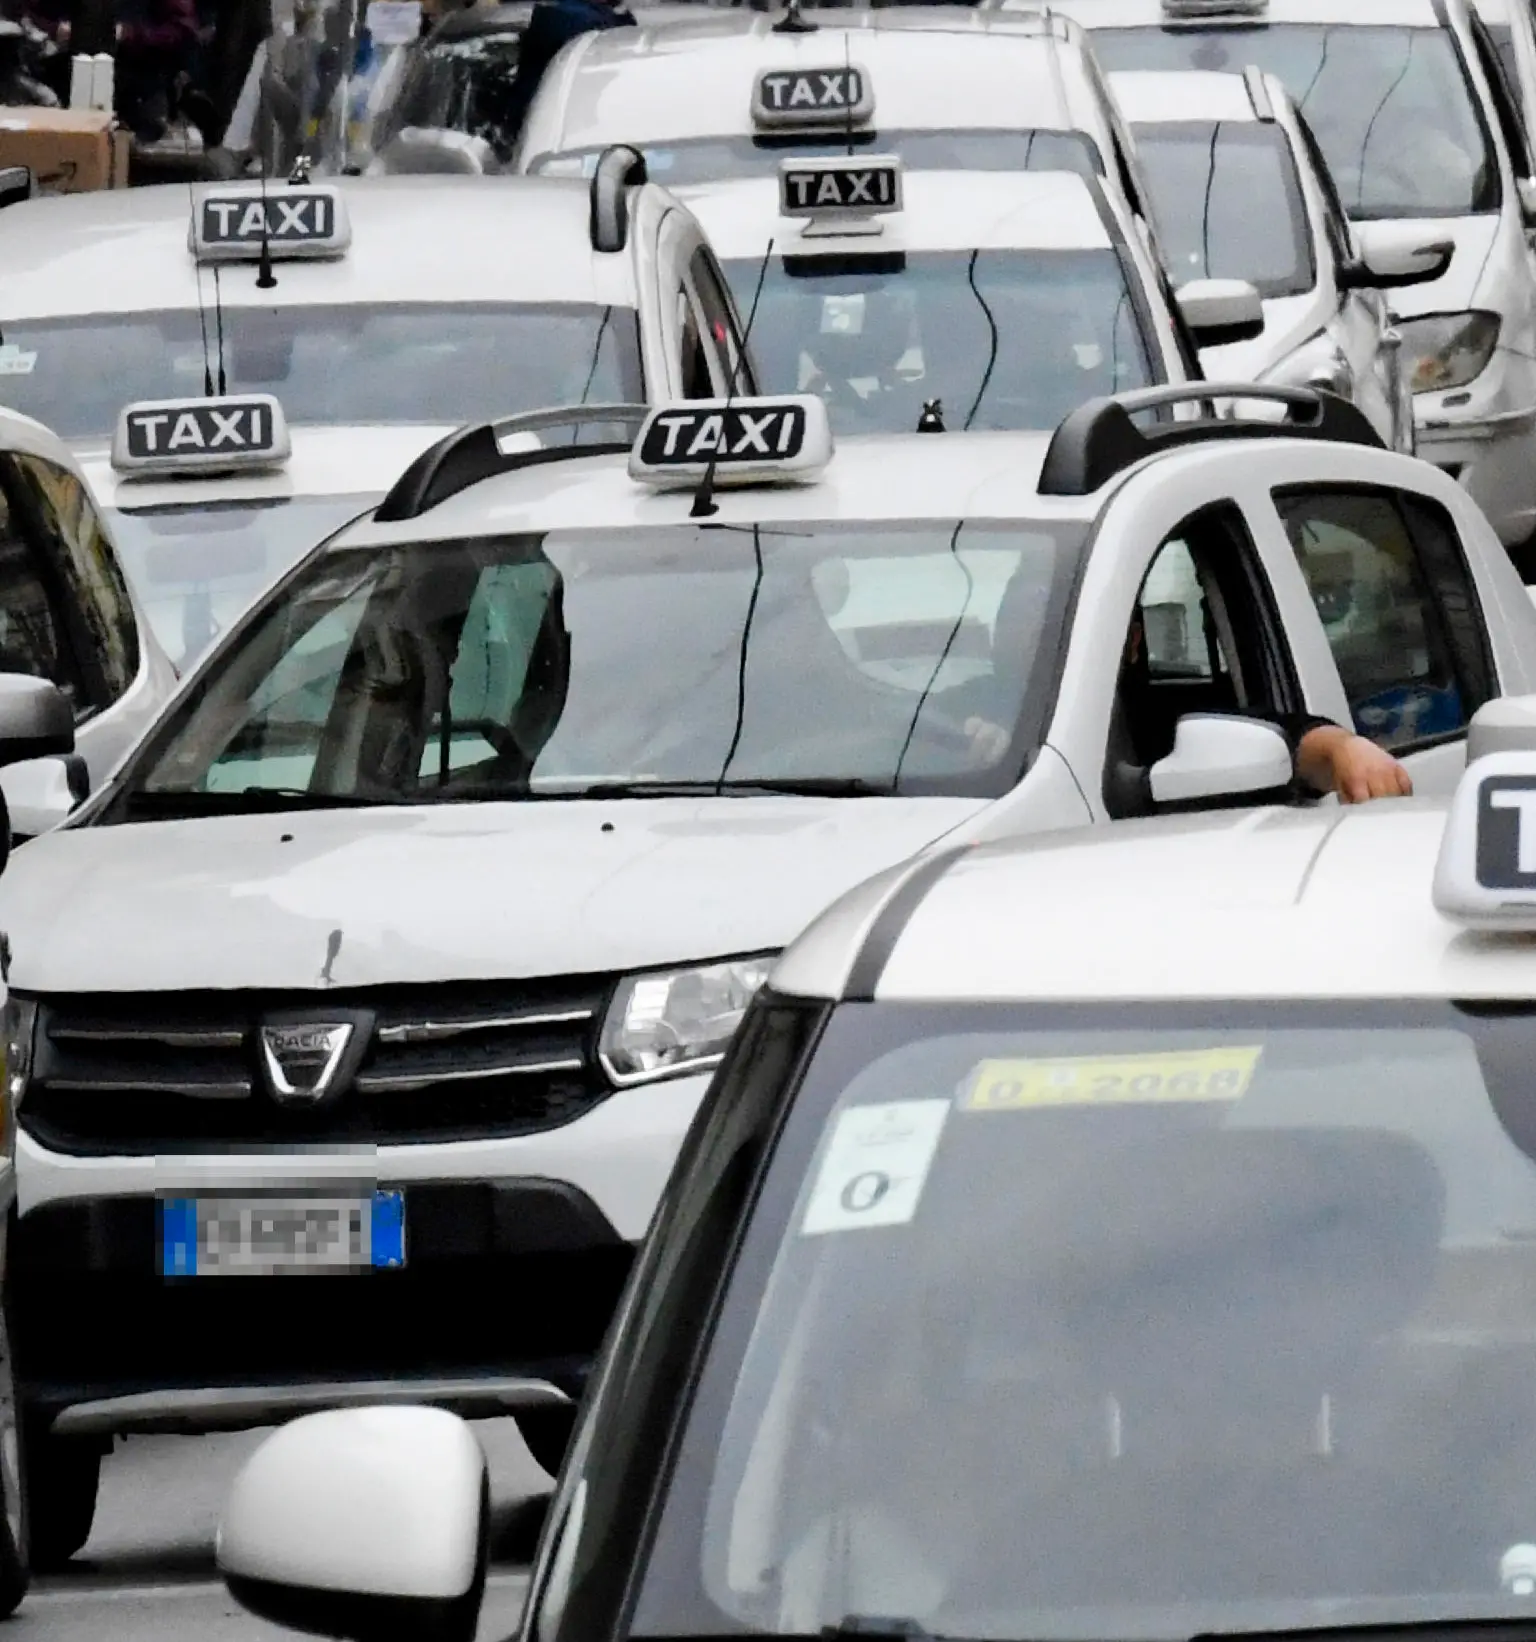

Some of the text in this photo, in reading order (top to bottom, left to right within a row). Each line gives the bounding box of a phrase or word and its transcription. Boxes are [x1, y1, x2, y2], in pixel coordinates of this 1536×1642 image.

[765, 73, 858, 107] TAXI
[789, 170, 889, 205] TAXI
[207, 199, 326, 238] TAXI
[133, 409, 262, 451] TAXI
[657, 412, 795, 457] TAXI
